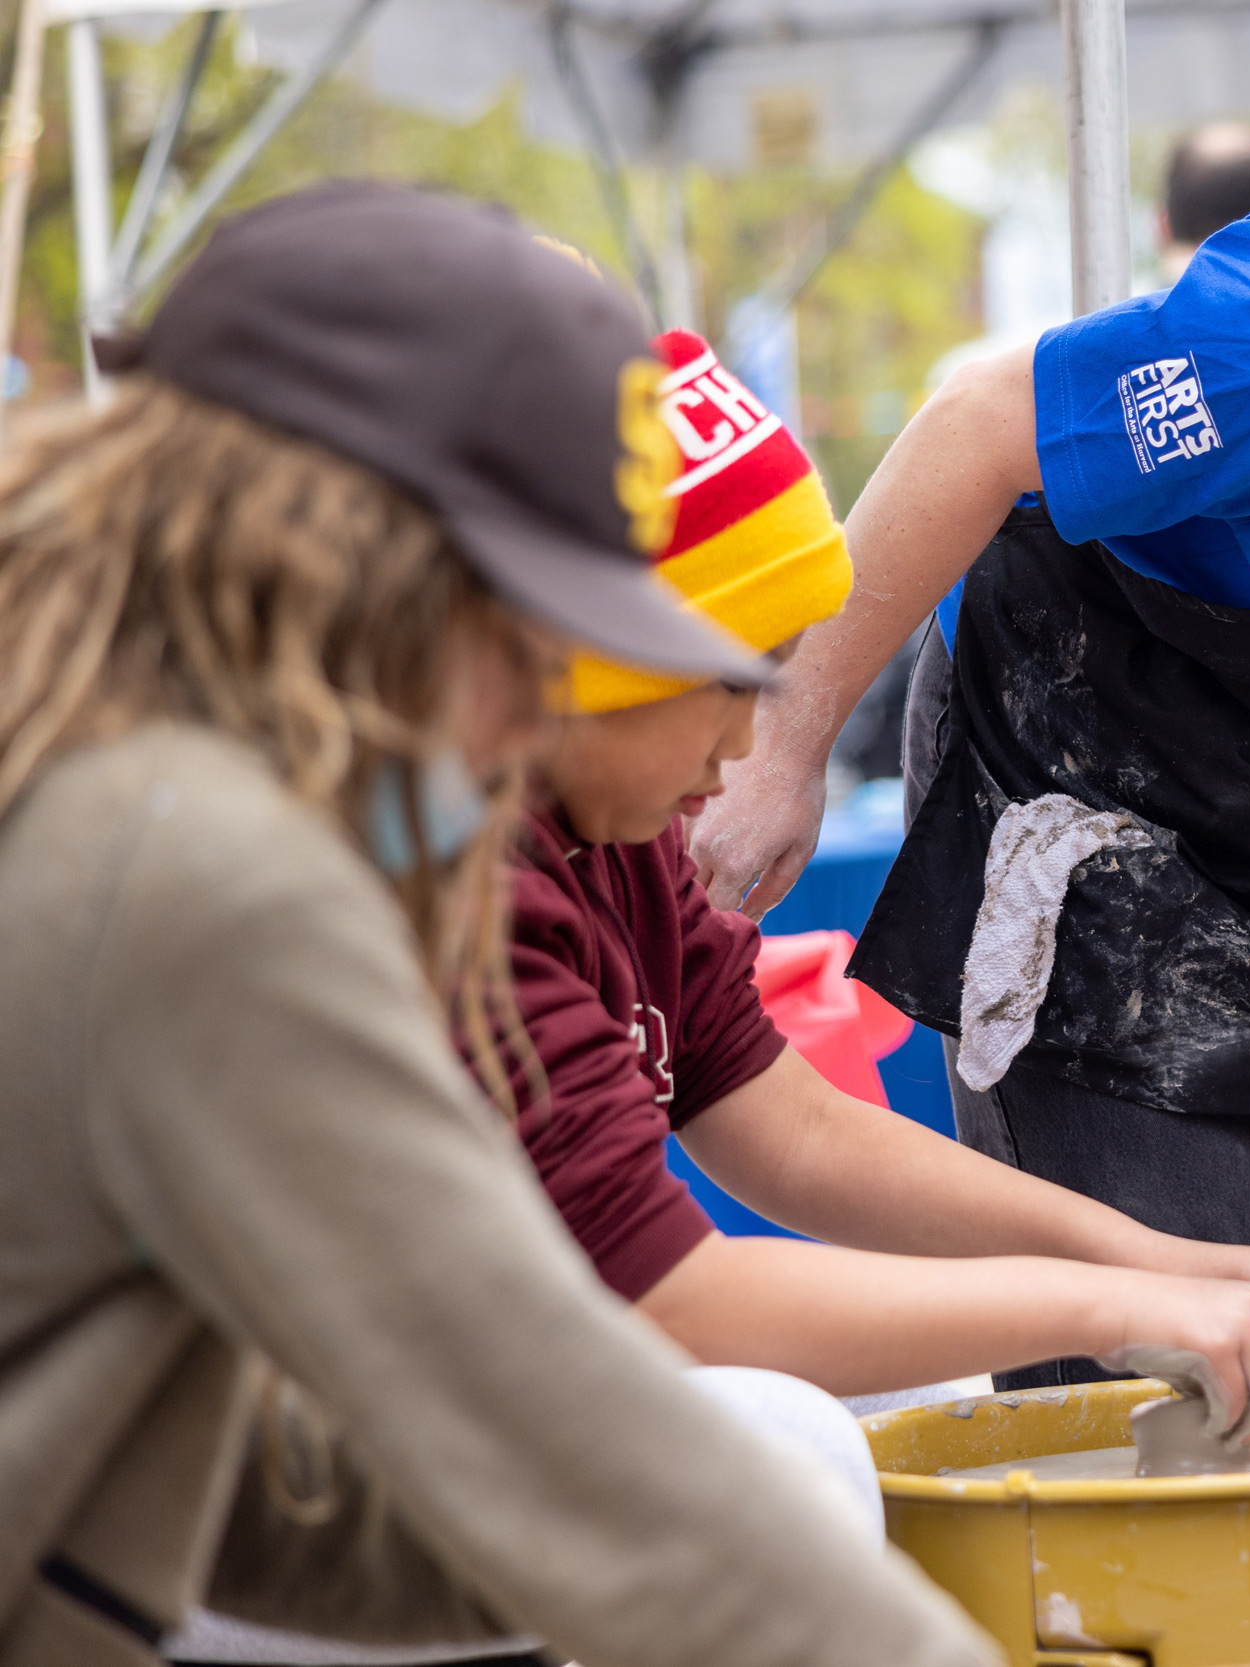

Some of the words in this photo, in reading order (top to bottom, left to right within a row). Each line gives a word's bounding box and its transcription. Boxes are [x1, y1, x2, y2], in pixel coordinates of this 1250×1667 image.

[1130, 363, 1192, 464] FIRST
[1155, 358, 1220, 456] ARTS
[1129, 419, 1137, 434] Arts
[1134, 434, 1140, 443] at
[1136, 443, 1152, 473] Harvard
